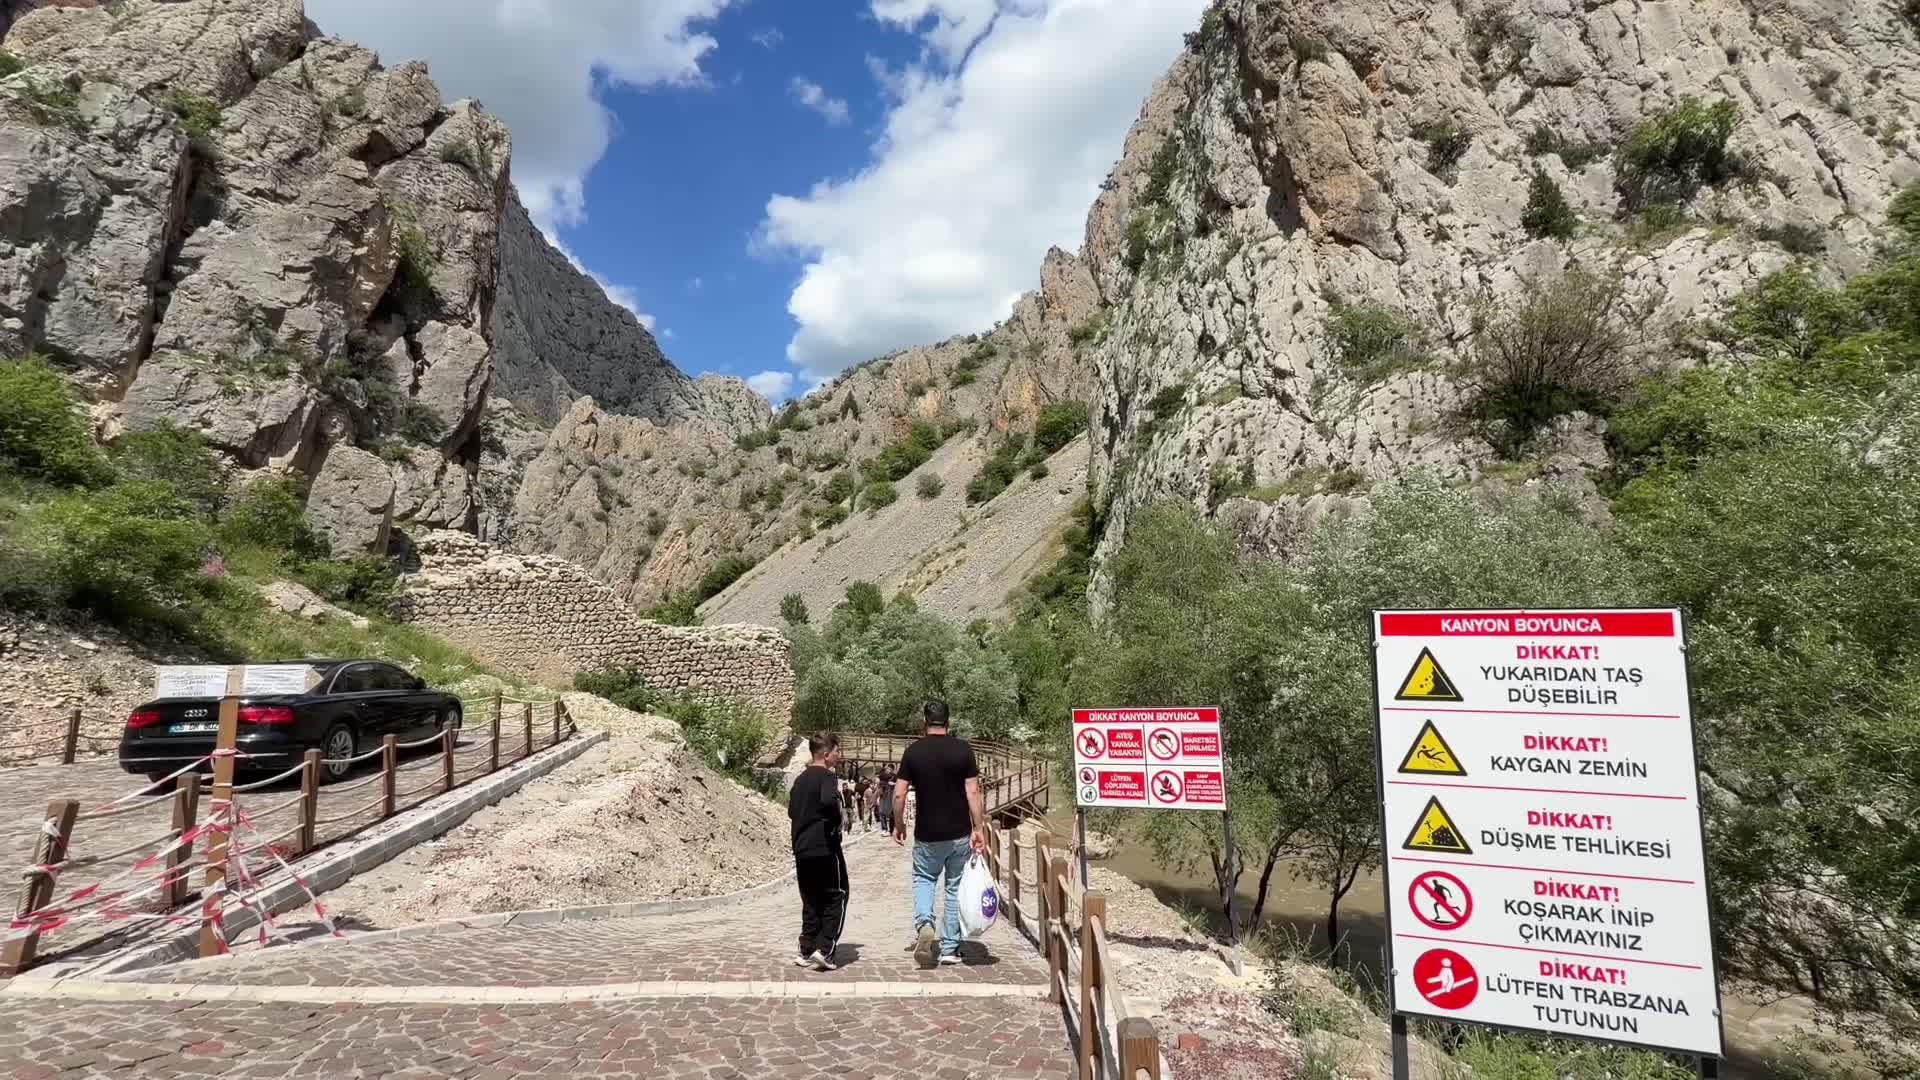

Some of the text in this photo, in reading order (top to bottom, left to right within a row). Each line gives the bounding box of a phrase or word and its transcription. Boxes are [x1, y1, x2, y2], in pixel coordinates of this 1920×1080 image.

[1441, 618, 1602, 632] KANYON BOYUNCA
[1516, 642, 1599, 660] DİKKAT!
[1480, 666, 1643, 687] YUKARIDAN TAŞ
[1508, 684, 1617, 707] DÜŞEBİLİR
[1089, 712, 1199, 721] DİKKAT KANYON BOYUNCA
[1524, 732, 1607, 752] DİKKAT!
[1491, 756, 1647, 777] KAYGAN ZEMİN
[1527, 807, 1612, 830] DİKKAT!
[1481, 826, 1671, 858] DÜŞME TEHLİKESİ
[1533, 878, 1620, 901] DİKKAT!
[1504, 900, 1654, 927] KOŞARAK İNİP
[1519, 925, 1642, 950] ÇIKMAYINIZ
[1540, 958, 1626, 985] DİKKAT!
[1486, 973, 1689, 1016] LÜTFEN TRABZANA
[1533, 1005, 1638, 1033] TUTUNUN
